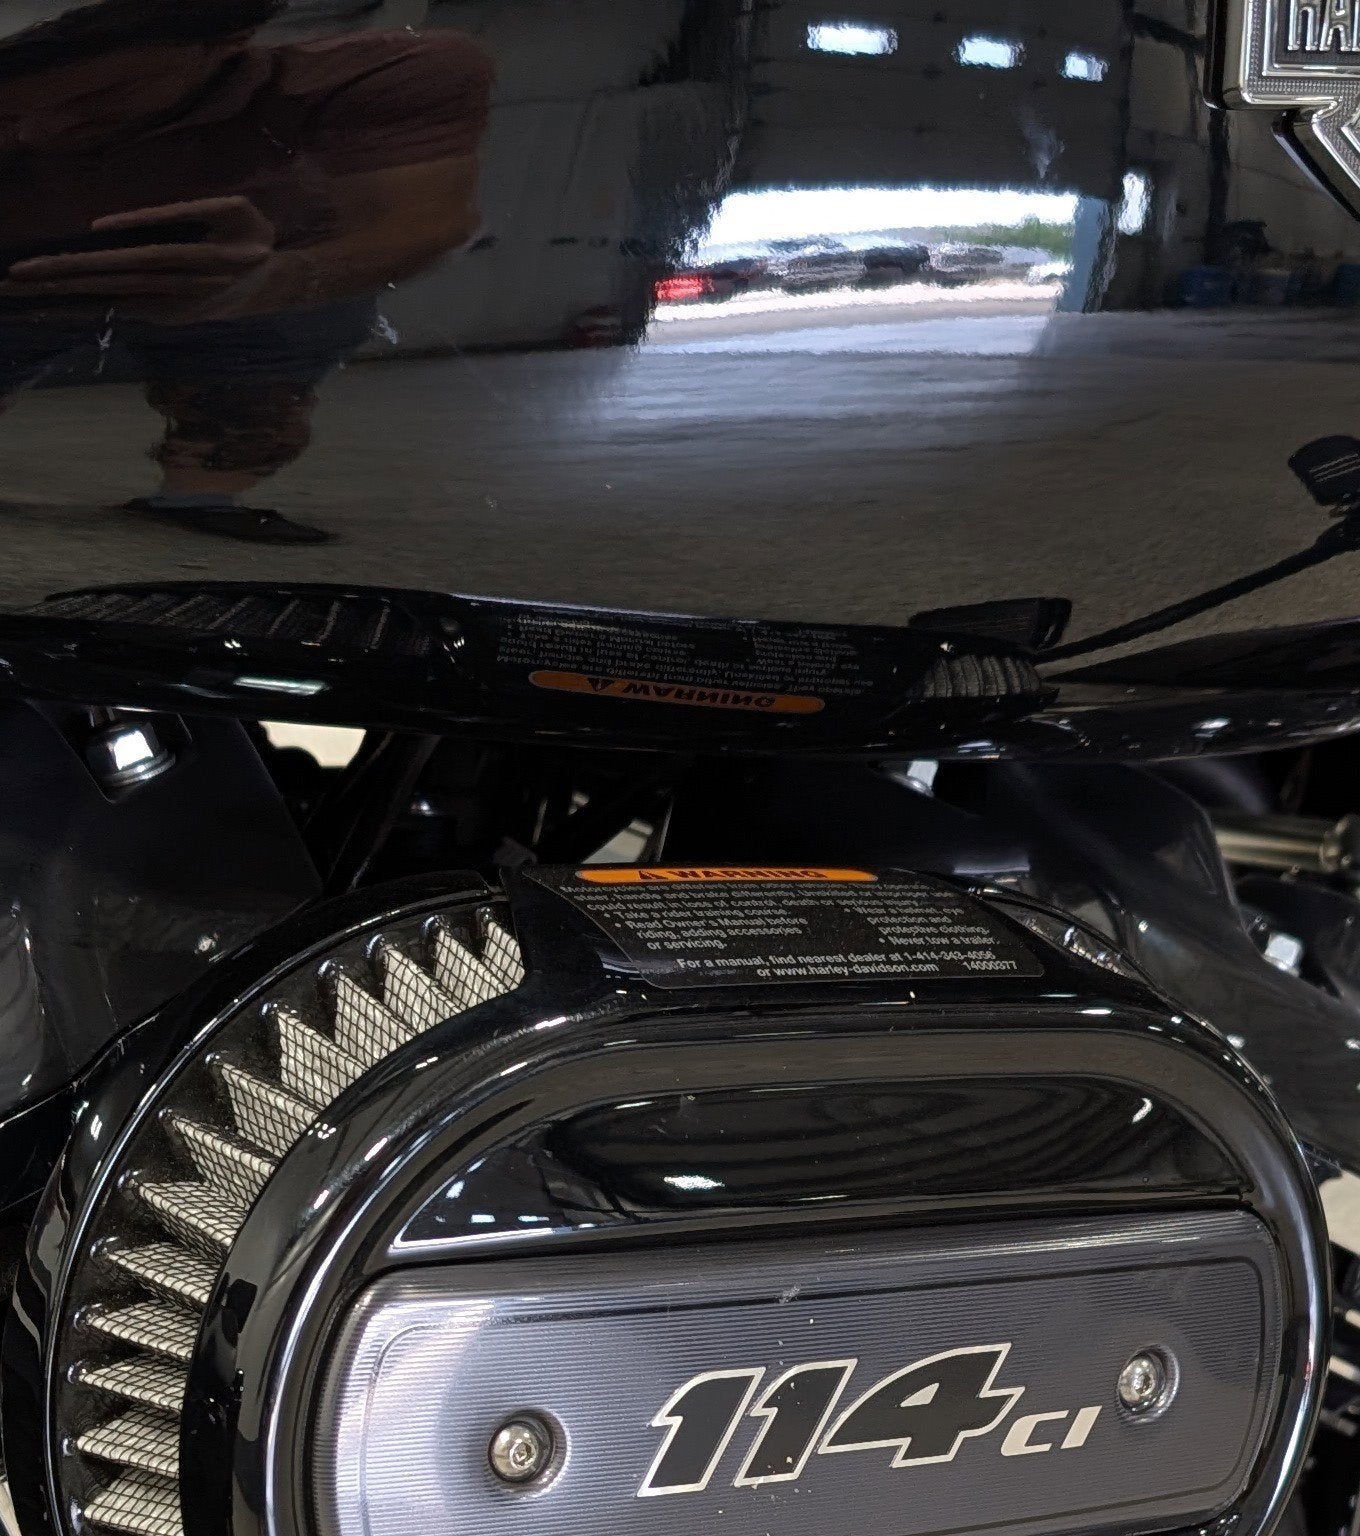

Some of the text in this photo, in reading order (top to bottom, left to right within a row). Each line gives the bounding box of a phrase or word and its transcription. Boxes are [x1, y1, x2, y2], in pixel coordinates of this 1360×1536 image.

[667, 870, 827, 879] WARNING
[613, 910, 649, 919] Take
[625, 916, 809, 929] Read Owner's Manual before
[636, 927, 802, 940] riding, adding accessories
[646, 939, 728, 950] or servicing.
[887, 936, 926, 945] Never
[676, 957, 702, 969] For
[703, 958, 715, 968] a
[715, 956, 770, 967] manual,
[768, 955, 796, 965] find
[797, 953, 848, 963] nearest
[847, 952, 887, 963] dealer
[888, 952, 903, 962] at
[757, 968, 771, 977] or
[773, 963, 940, 976] www.harley-davidson.com
[637, 1342, 1026, 1498] 114
